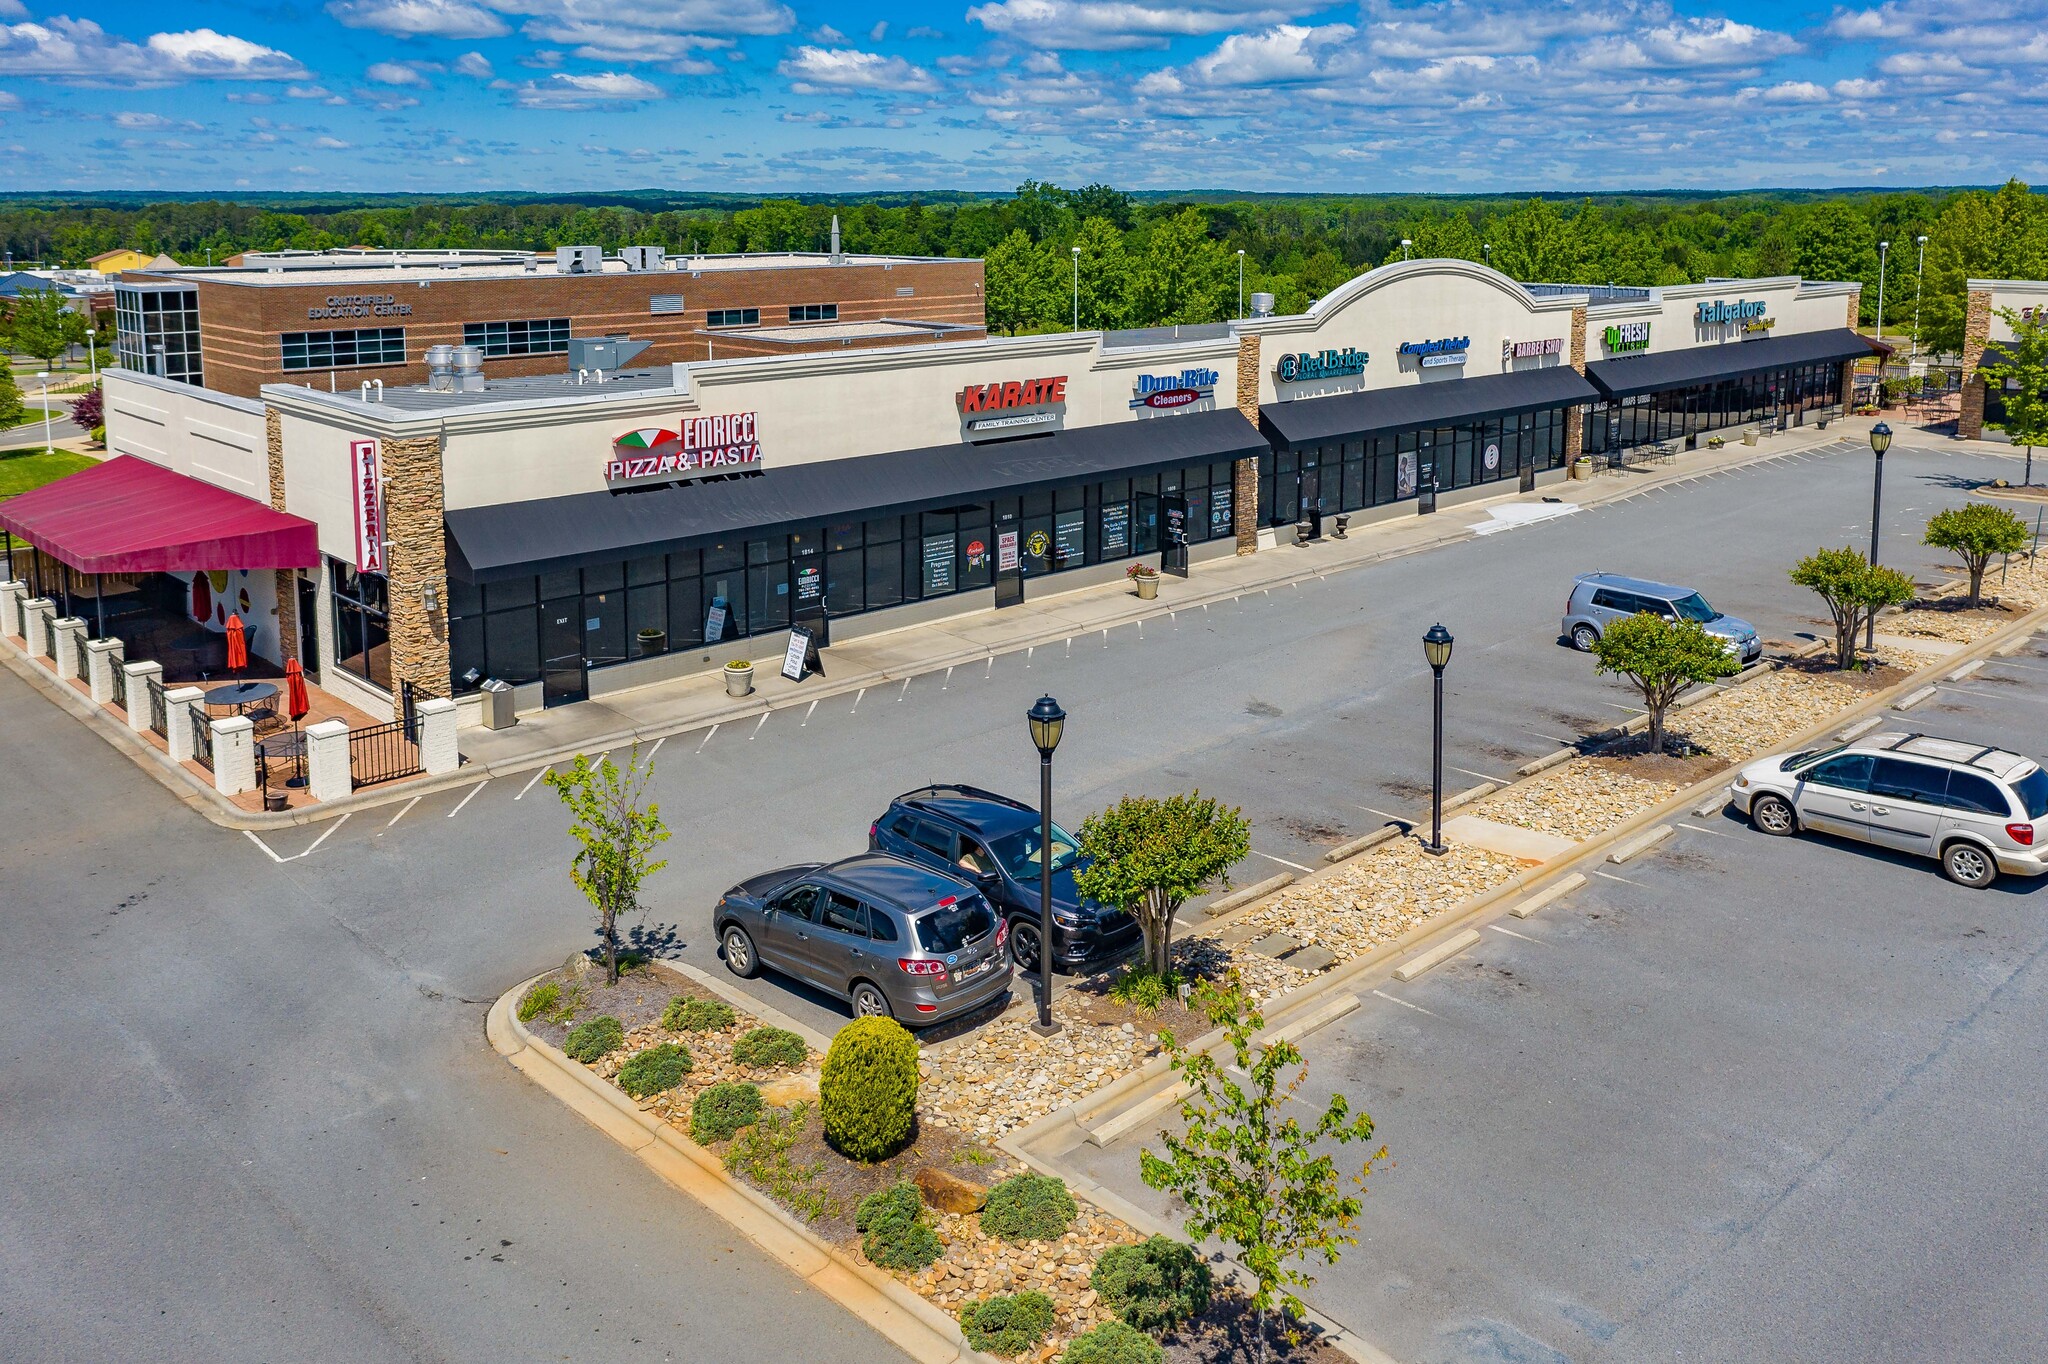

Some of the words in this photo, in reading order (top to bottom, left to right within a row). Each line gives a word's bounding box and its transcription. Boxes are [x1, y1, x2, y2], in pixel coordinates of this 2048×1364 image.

[308, 306, 370, 319] EDUCATION
[373, 304, 413, 316] CENTER
[326, 294, 396, 307] CRUTCHFIELD
[1697, 299, 1767, 325] Tailgators
[1400, 340, 1442, 356] Compleat
[1443, 336, 1471, 350] Rehab
[1514, 341, 1545, 357] BARBER
[1544, 339, 1564, 354] SHOP
[1298, 351, 1325, 372] Red
[1325, 347, 1369, 370] Bridge
[1433, 357, 1448, 365] Sports
[1449, 355, 1467, 364] Therapy
[1138, 368, 1219, 393] Dun-Rite
[963, 376, 1068, 413] KARATE
[1153, 393, 1192, 406] Cleaners
[681, 412, 760, 449] EMRICCI
[978, 420, 1000, 429] FAMILY
[1001, 417, 1030, 427] TRAINING
[1031, 415, 1055, 423] CENTER
[608, 455, 672, 481] PIZZA
[675, 451, 692, 471] &
[699, 444, 765, 469] PASTA
[362, 447, 379, 569] PIZZERIA
